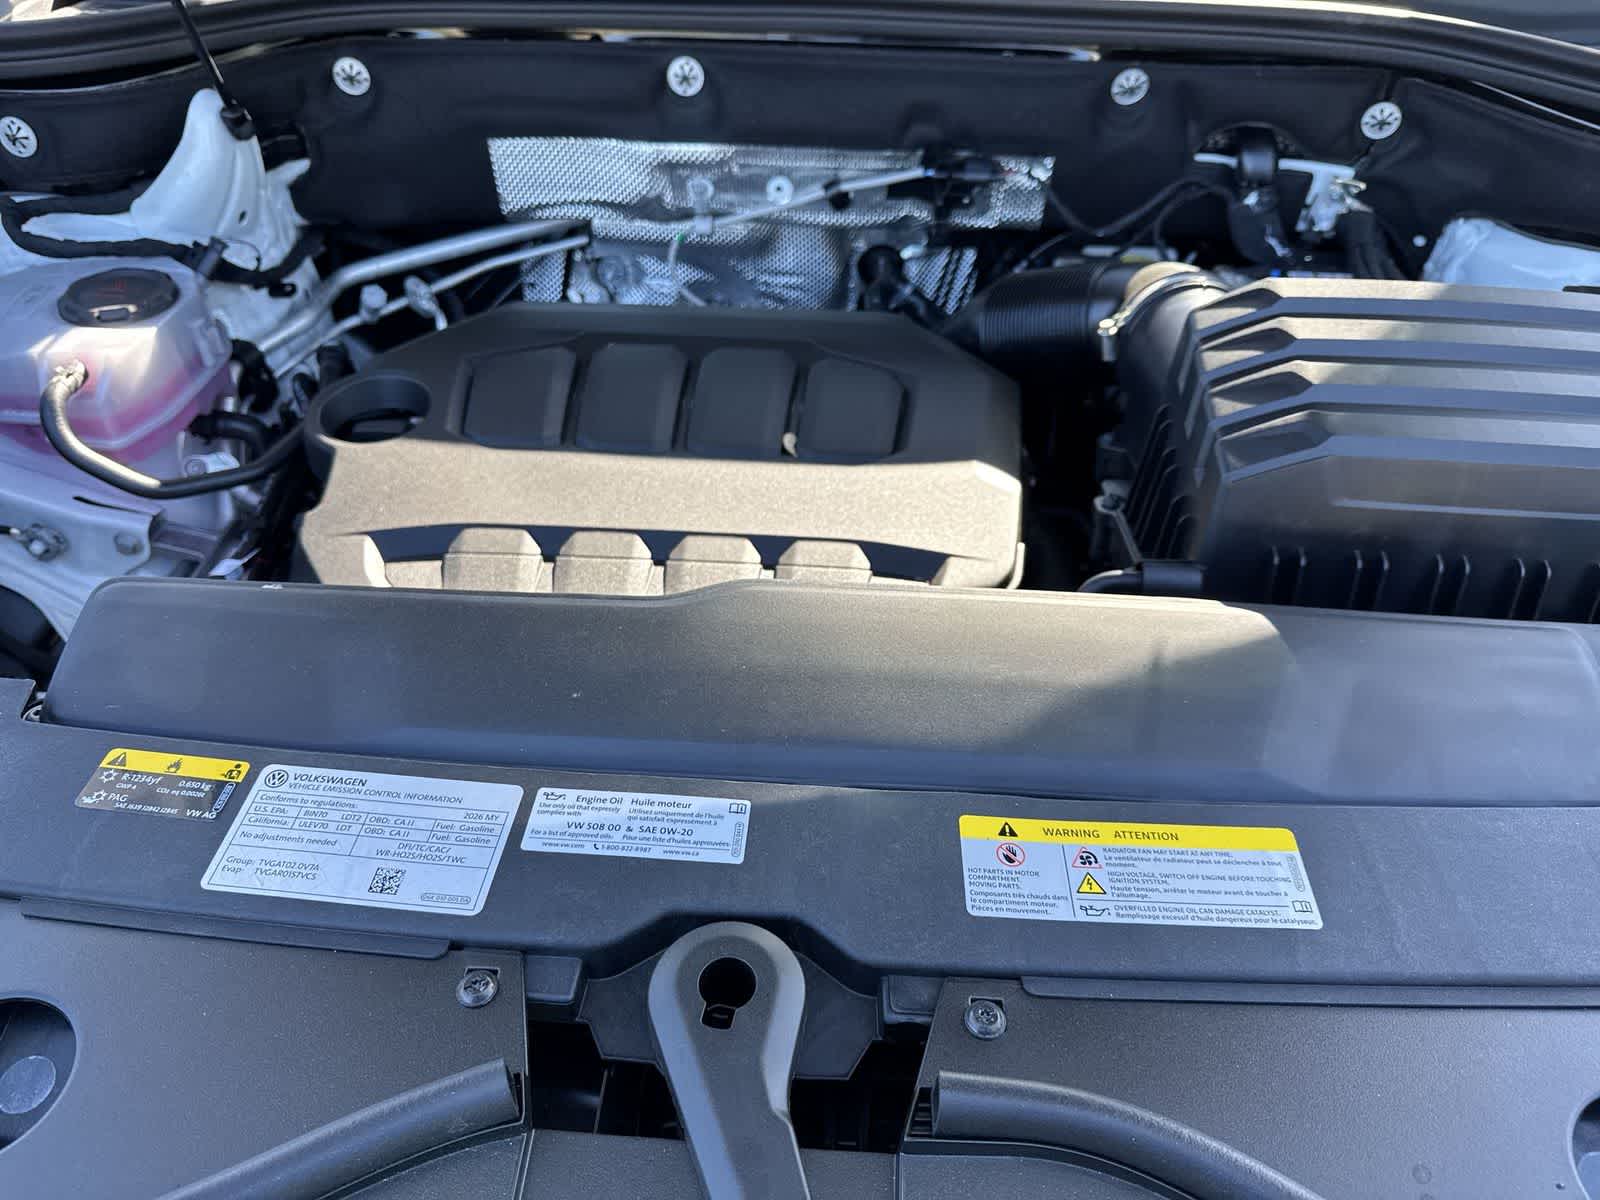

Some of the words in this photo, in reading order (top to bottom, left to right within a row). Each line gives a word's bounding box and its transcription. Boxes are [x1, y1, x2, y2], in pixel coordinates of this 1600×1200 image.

[120, 773, 163, 786] R-1234yf
[291, 773, 368, 787] VOLKSWAGEN
[199, 780, 212, 793] kg
[287, 782, 321, 791] VEHICLE
[322, 785, 363, 795] EMISSION
[363, 789, 403, 799] CONTROL
[403, 792, 464, 804] INFORMATION
[107, 793, 130, 802] PAG
[259, 794, 300, 804] Conforms
[575, 795, 609, 805] Engine
[609, 797, 624, 805] Oil
[631, 798, 657, 807] Huile
[657, 800, 692, 809] moteur
[185, 808, 203, 819] VW
[201, 811, 218, 819] AG
[463, 812, 484, 820] 2026
[484, 814, 500, 822] MY
[340, 813, 363, 821] LDT2
[368, 816, 392, 824] OBD:
[435, 822, 457, 830] Fuel:
[458, 824, 496, 833] Gasoline
[566, 821, 585, 829] VW
[586, 822, 606, 831] 508
[607, 824, 622, 832] 00
[625, 825, 634, 833] &
[638, 825, 658, 834] SAE
[659, 826, 694, 836] 0W-20
[252, 832, 306, 845] adjustments
[305, 837, 338, 846] needed
[297, 820, 330, 830] ULEV70
[335, 824, 353, 832] LDT
[363, 827, 387, 835] OBD:
[388, 829, 403, 837] CA
[431, 833, 452, 841] Fuel:
[454, 835, 492, 845] Gasoline
[567, 832, 599, 840] approved
[1043, 828, 1100, 838] WARNING
[1113, 830, 1179, 841] ATTENTION
[224, 856, 256, 867] Group:
[970, 890, 1012, 898] Composants
[1026, 892, 1051, 900] chauds
[978, 898, 1029, 908] compartiment
[1115, 912, 1160, 921] Remplissage
[1215, 915, 1254, 924] dangereux
